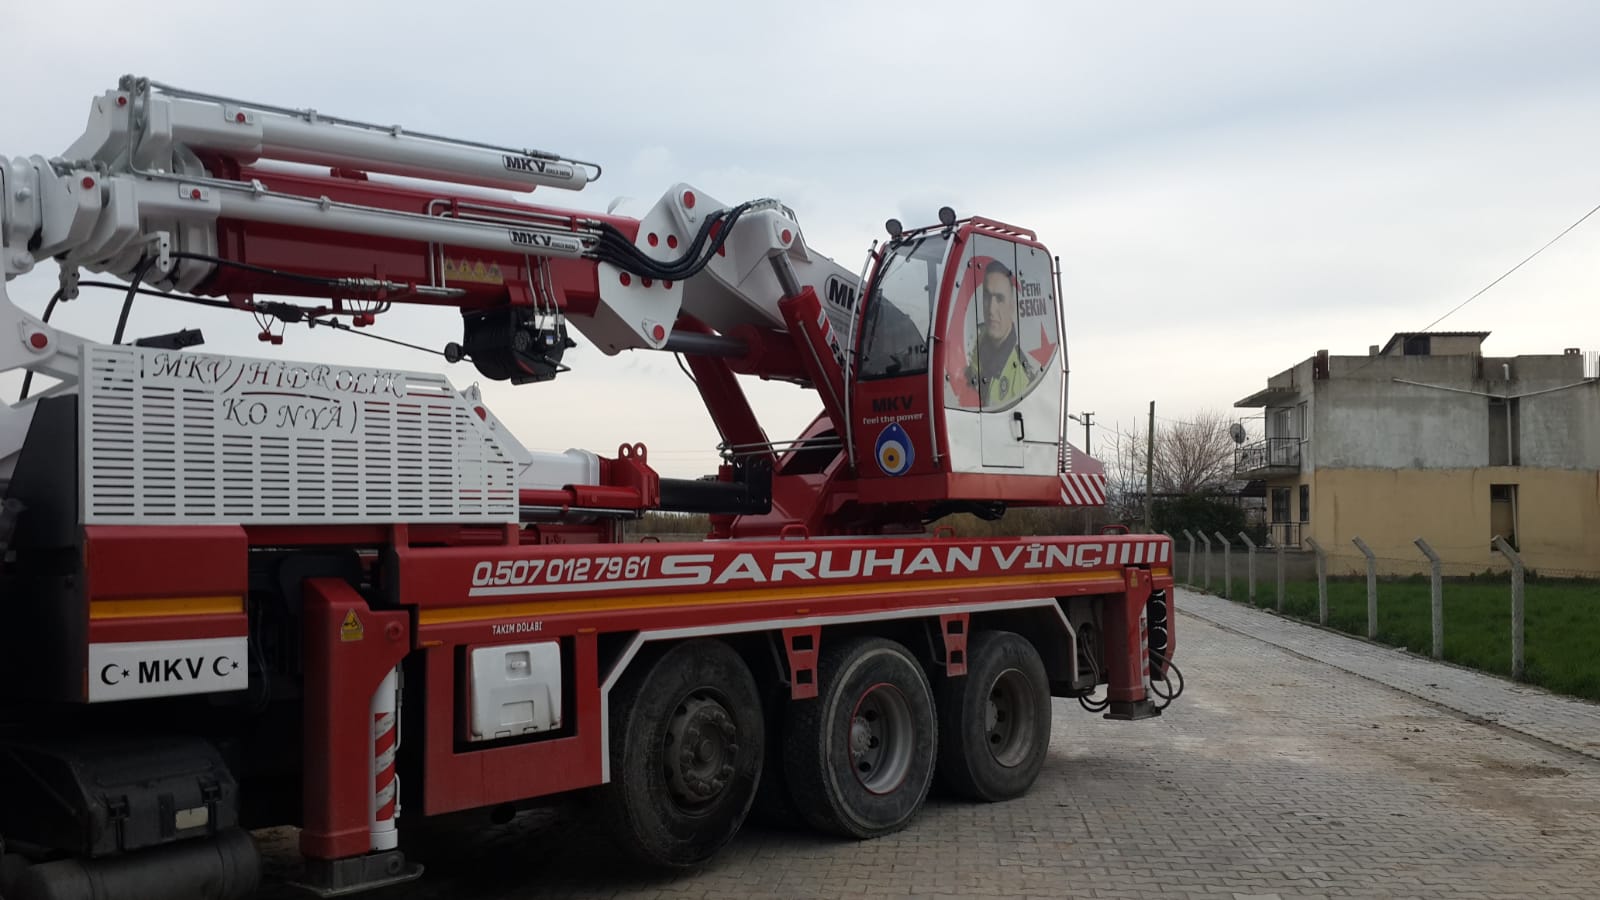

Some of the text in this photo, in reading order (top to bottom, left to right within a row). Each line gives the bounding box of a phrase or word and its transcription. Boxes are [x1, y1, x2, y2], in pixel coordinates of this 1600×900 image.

[505, 156, 546, 173] MKV
[512, 231, 552, 247] MKV
[872, 395, 914, 413] MKV
[881, 415, 896, 423] the
[897, 413, 925, 423] power
[472, 559, 546, 586] 0.507
[546, 557, 591, 582] 012
[659, 547, 982, 584] SARUHAN
[492, 620, 543, 635] TAKIM DOLABI
[138, 656, 205, 684] MKV
